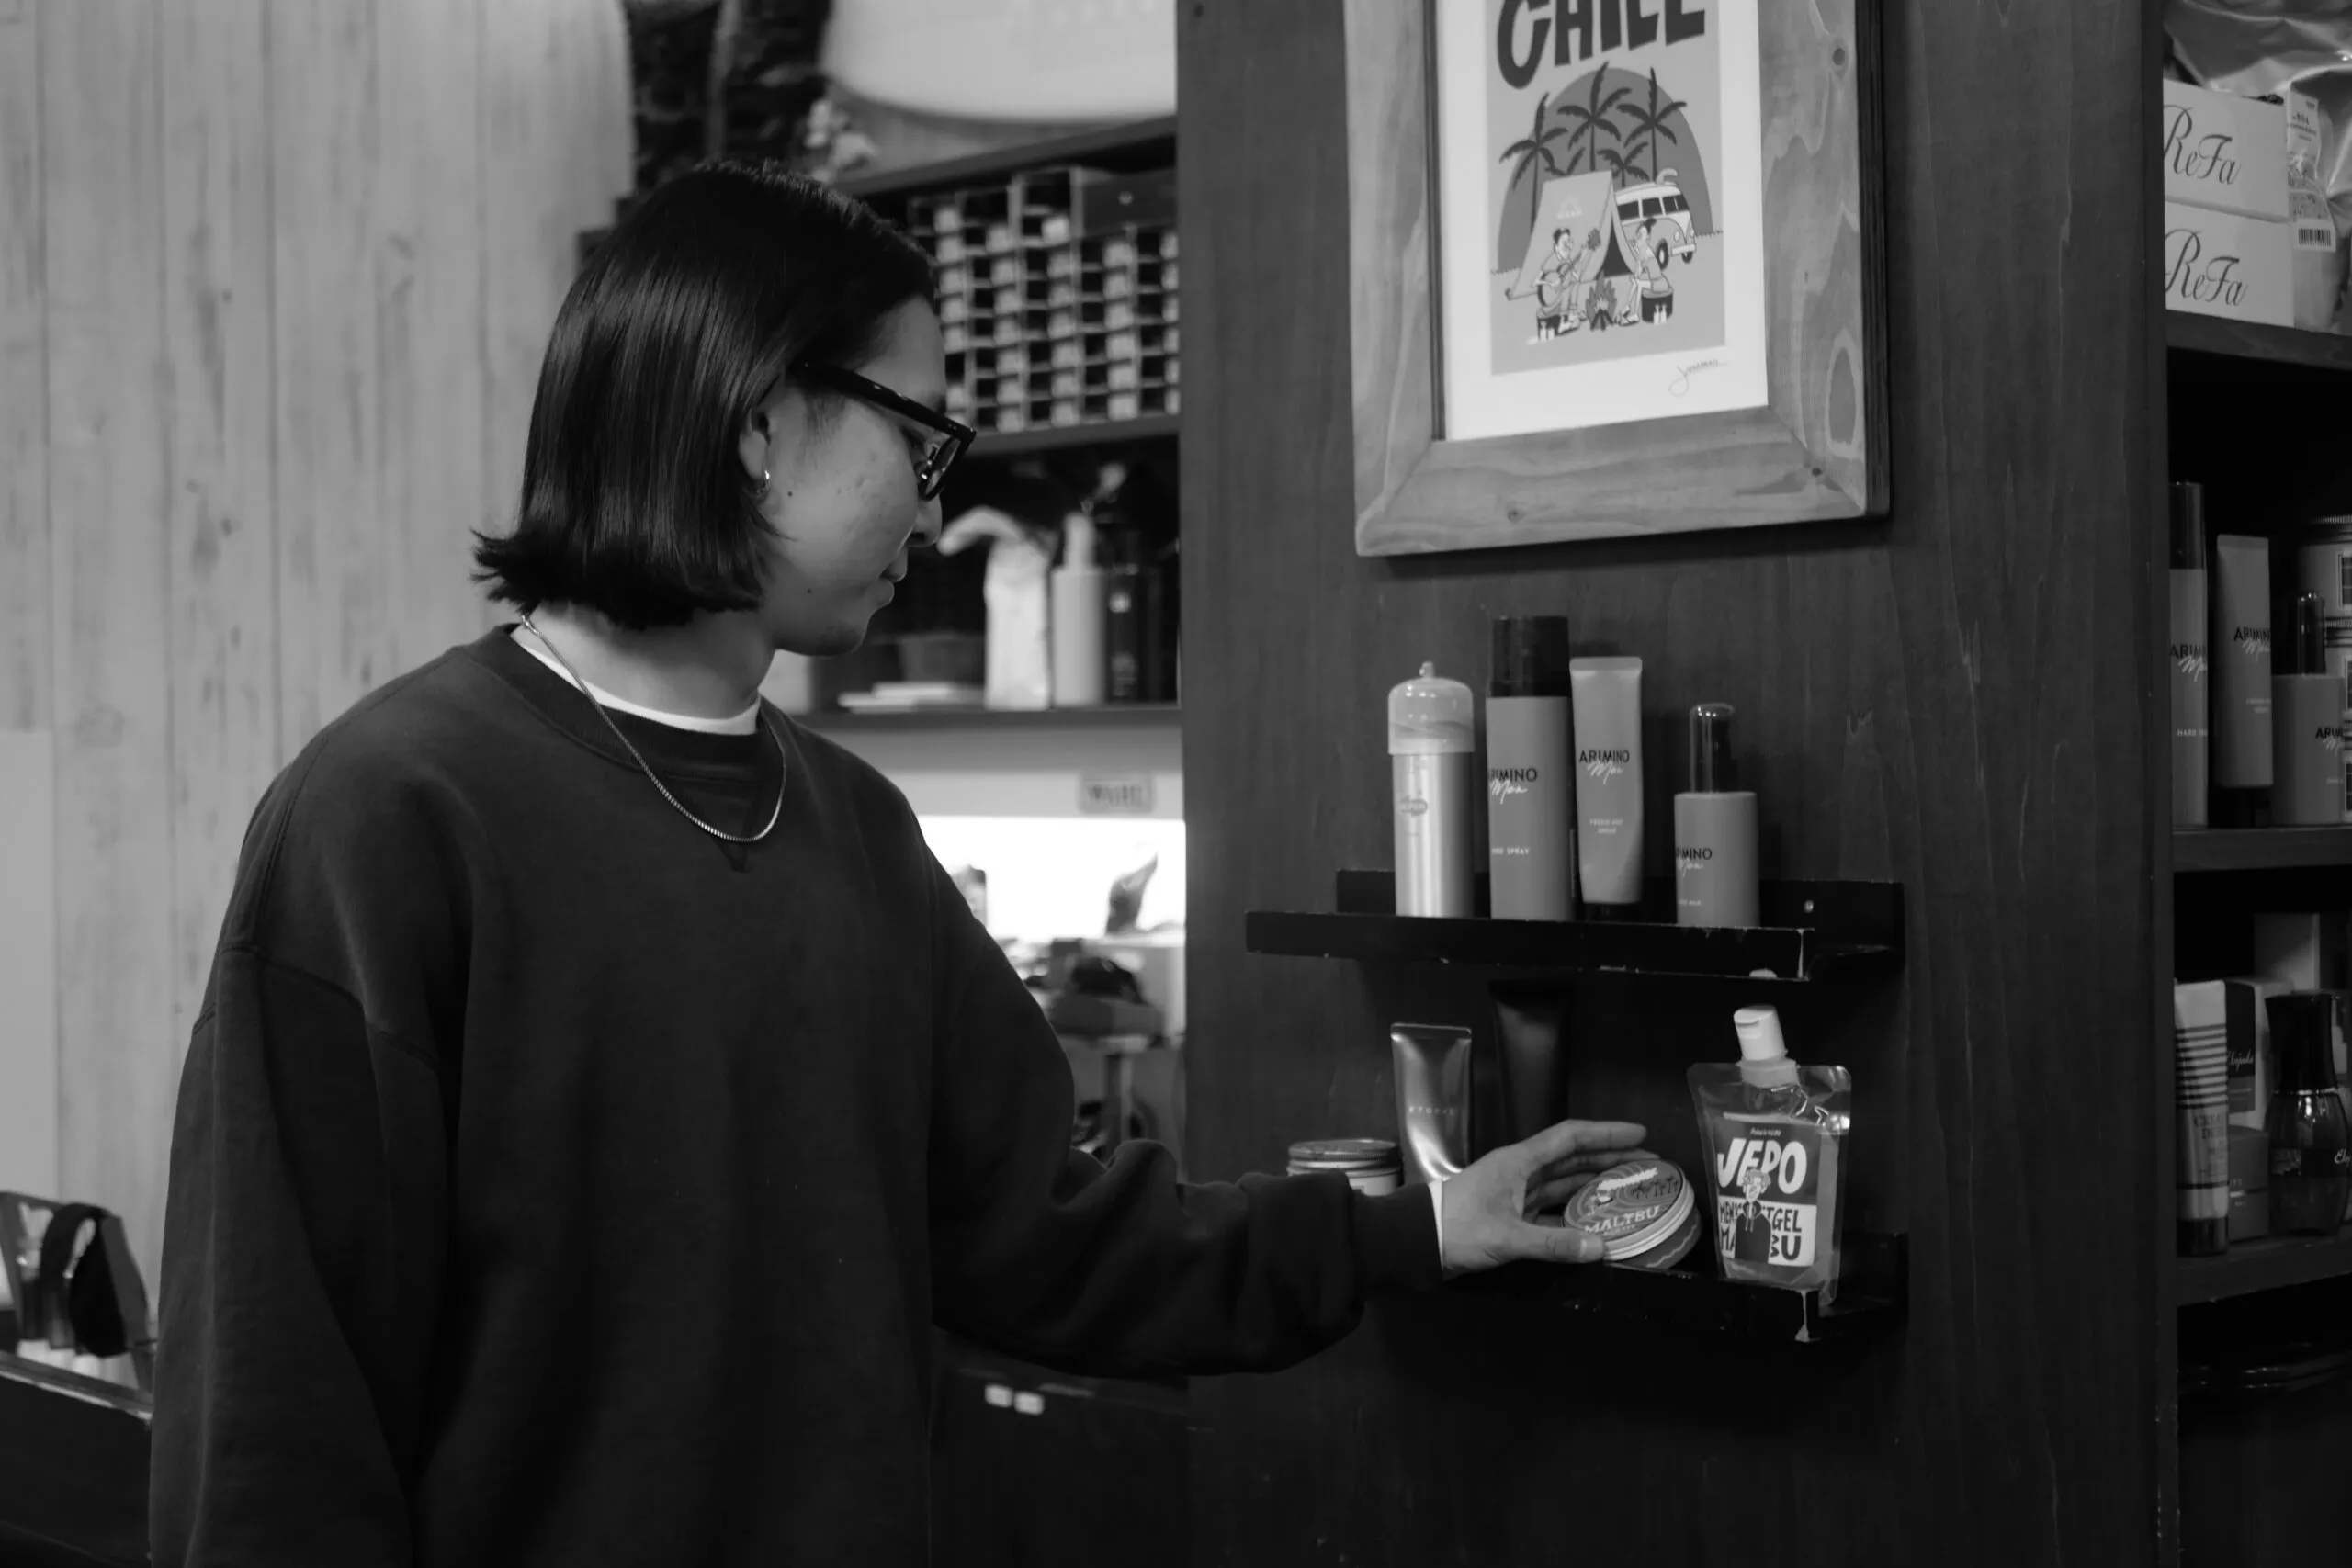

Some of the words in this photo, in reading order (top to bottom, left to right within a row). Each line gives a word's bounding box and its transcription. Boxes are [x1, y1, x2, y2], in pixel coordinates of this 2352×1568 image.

[1498, 0, 1705, 89] CHILL
[2164, 105, 2242, 185] ReFa
[2165, 229, 2248, 306] ReFa
[1488, 768, 1538, 783] RIMINO
[1578, 750, 1630, 763] ARIMINO
[1587, 761, 1623, 785] Men
[1507, 847, 1530, 855] SPRAY
[1717, 1137, 1807, 1194] JEPO
